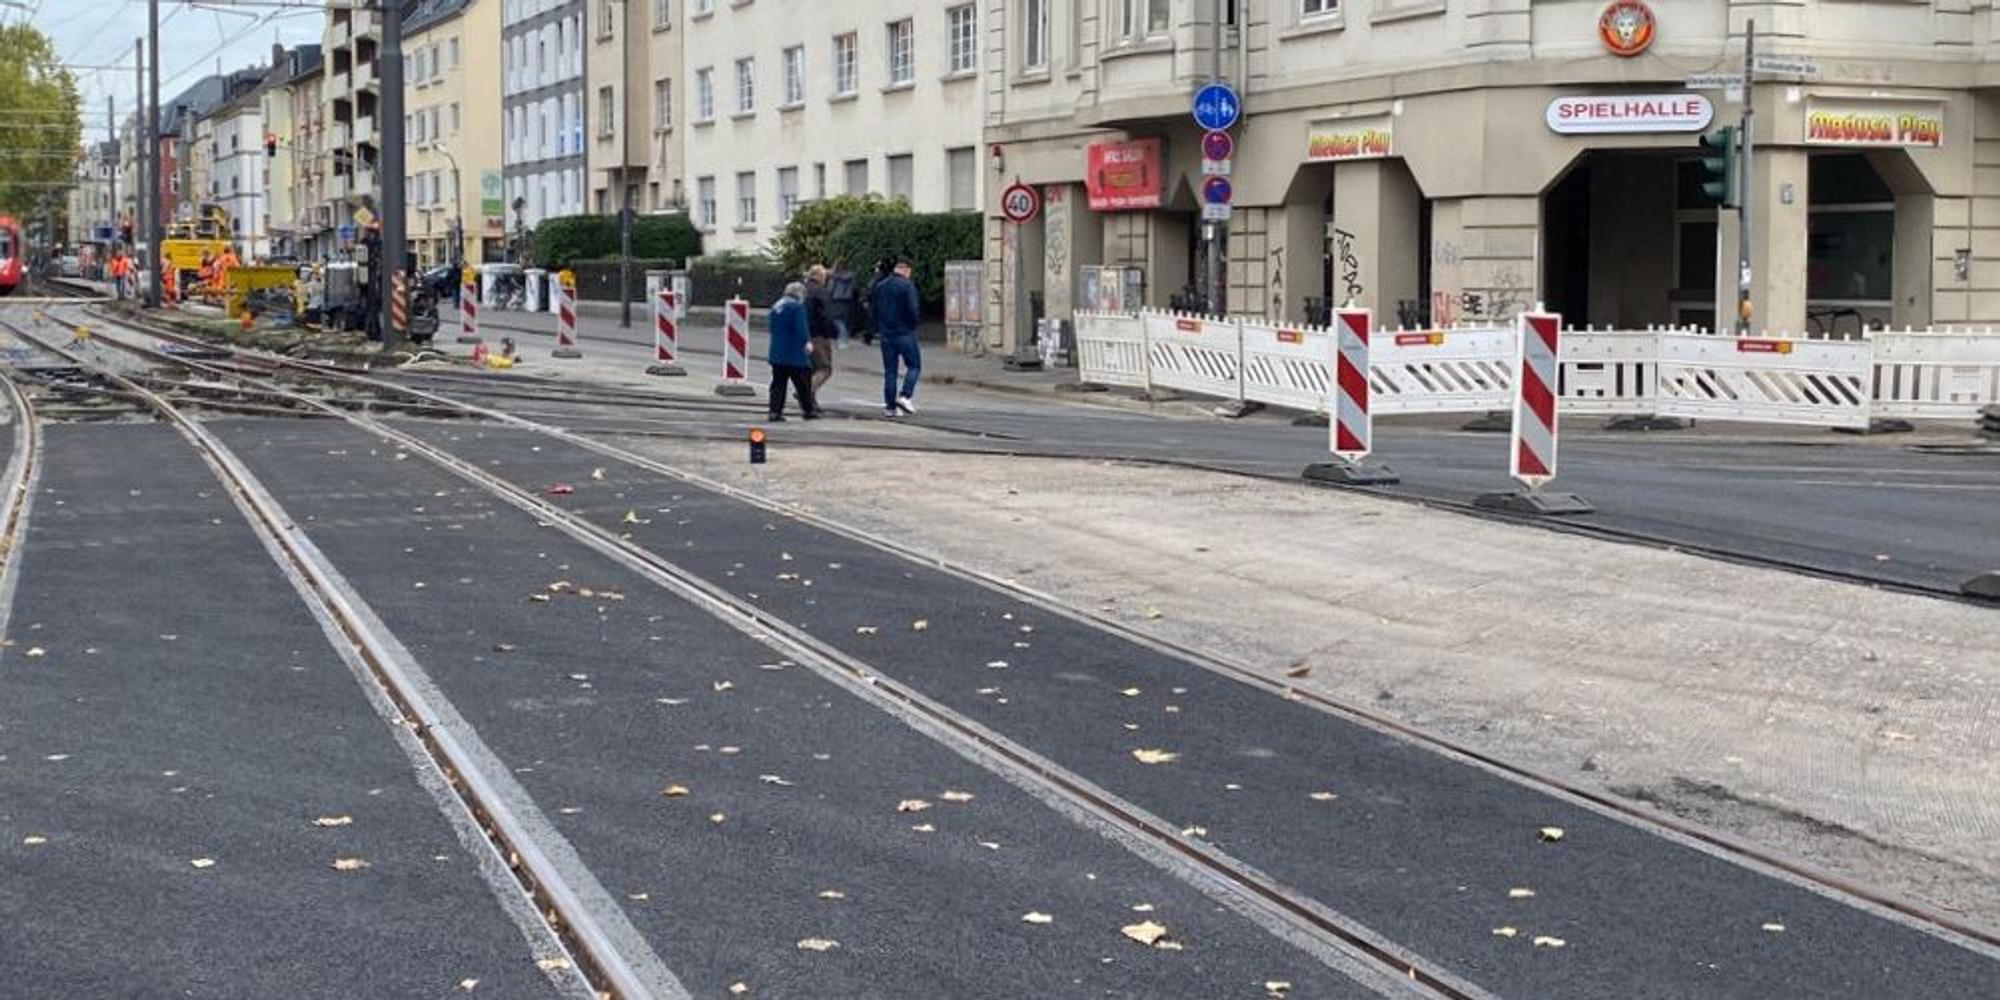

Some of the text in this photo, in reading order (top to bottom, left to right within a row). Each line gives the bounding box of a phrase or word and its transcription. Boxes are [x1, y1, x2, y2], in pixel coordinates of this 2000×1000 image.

[1558, 101, 1700, 118] SPIELHALLE
[1808, 111, 1941, 147] Medusa Play
[1361, 128, 1390, 156] Play
[1008, 194, 1030, 213] 40
